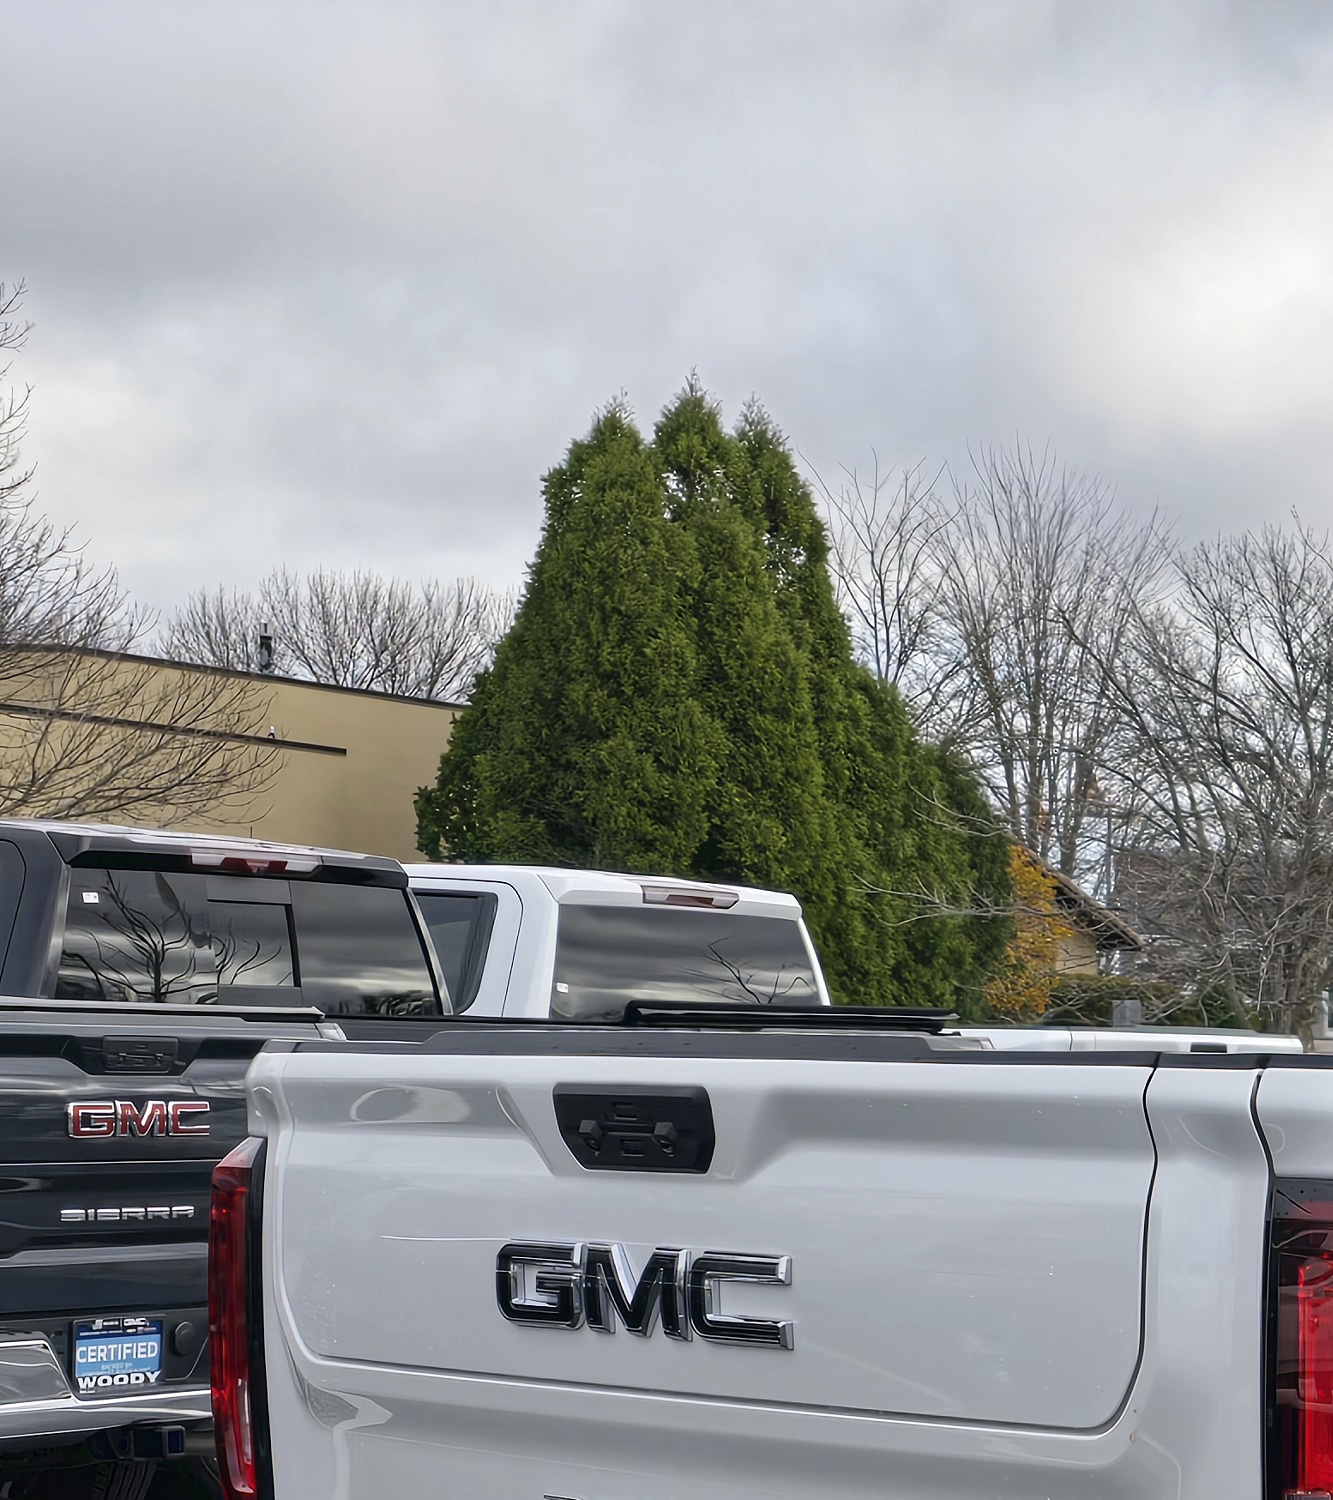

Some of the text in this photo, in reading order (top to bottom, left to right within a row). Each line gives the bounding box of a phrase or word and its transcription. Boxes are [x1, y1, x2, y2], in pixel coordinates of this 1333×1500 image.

[67, 1100, 210, 1138] GMC
[60, 1205, 195, 1222] SIERRA
[496, 1241, 795, 1351] GMC
[76, 1341, 158, 1363] CERTIFIED
[78, 1371, 160, 1389] WOODY
